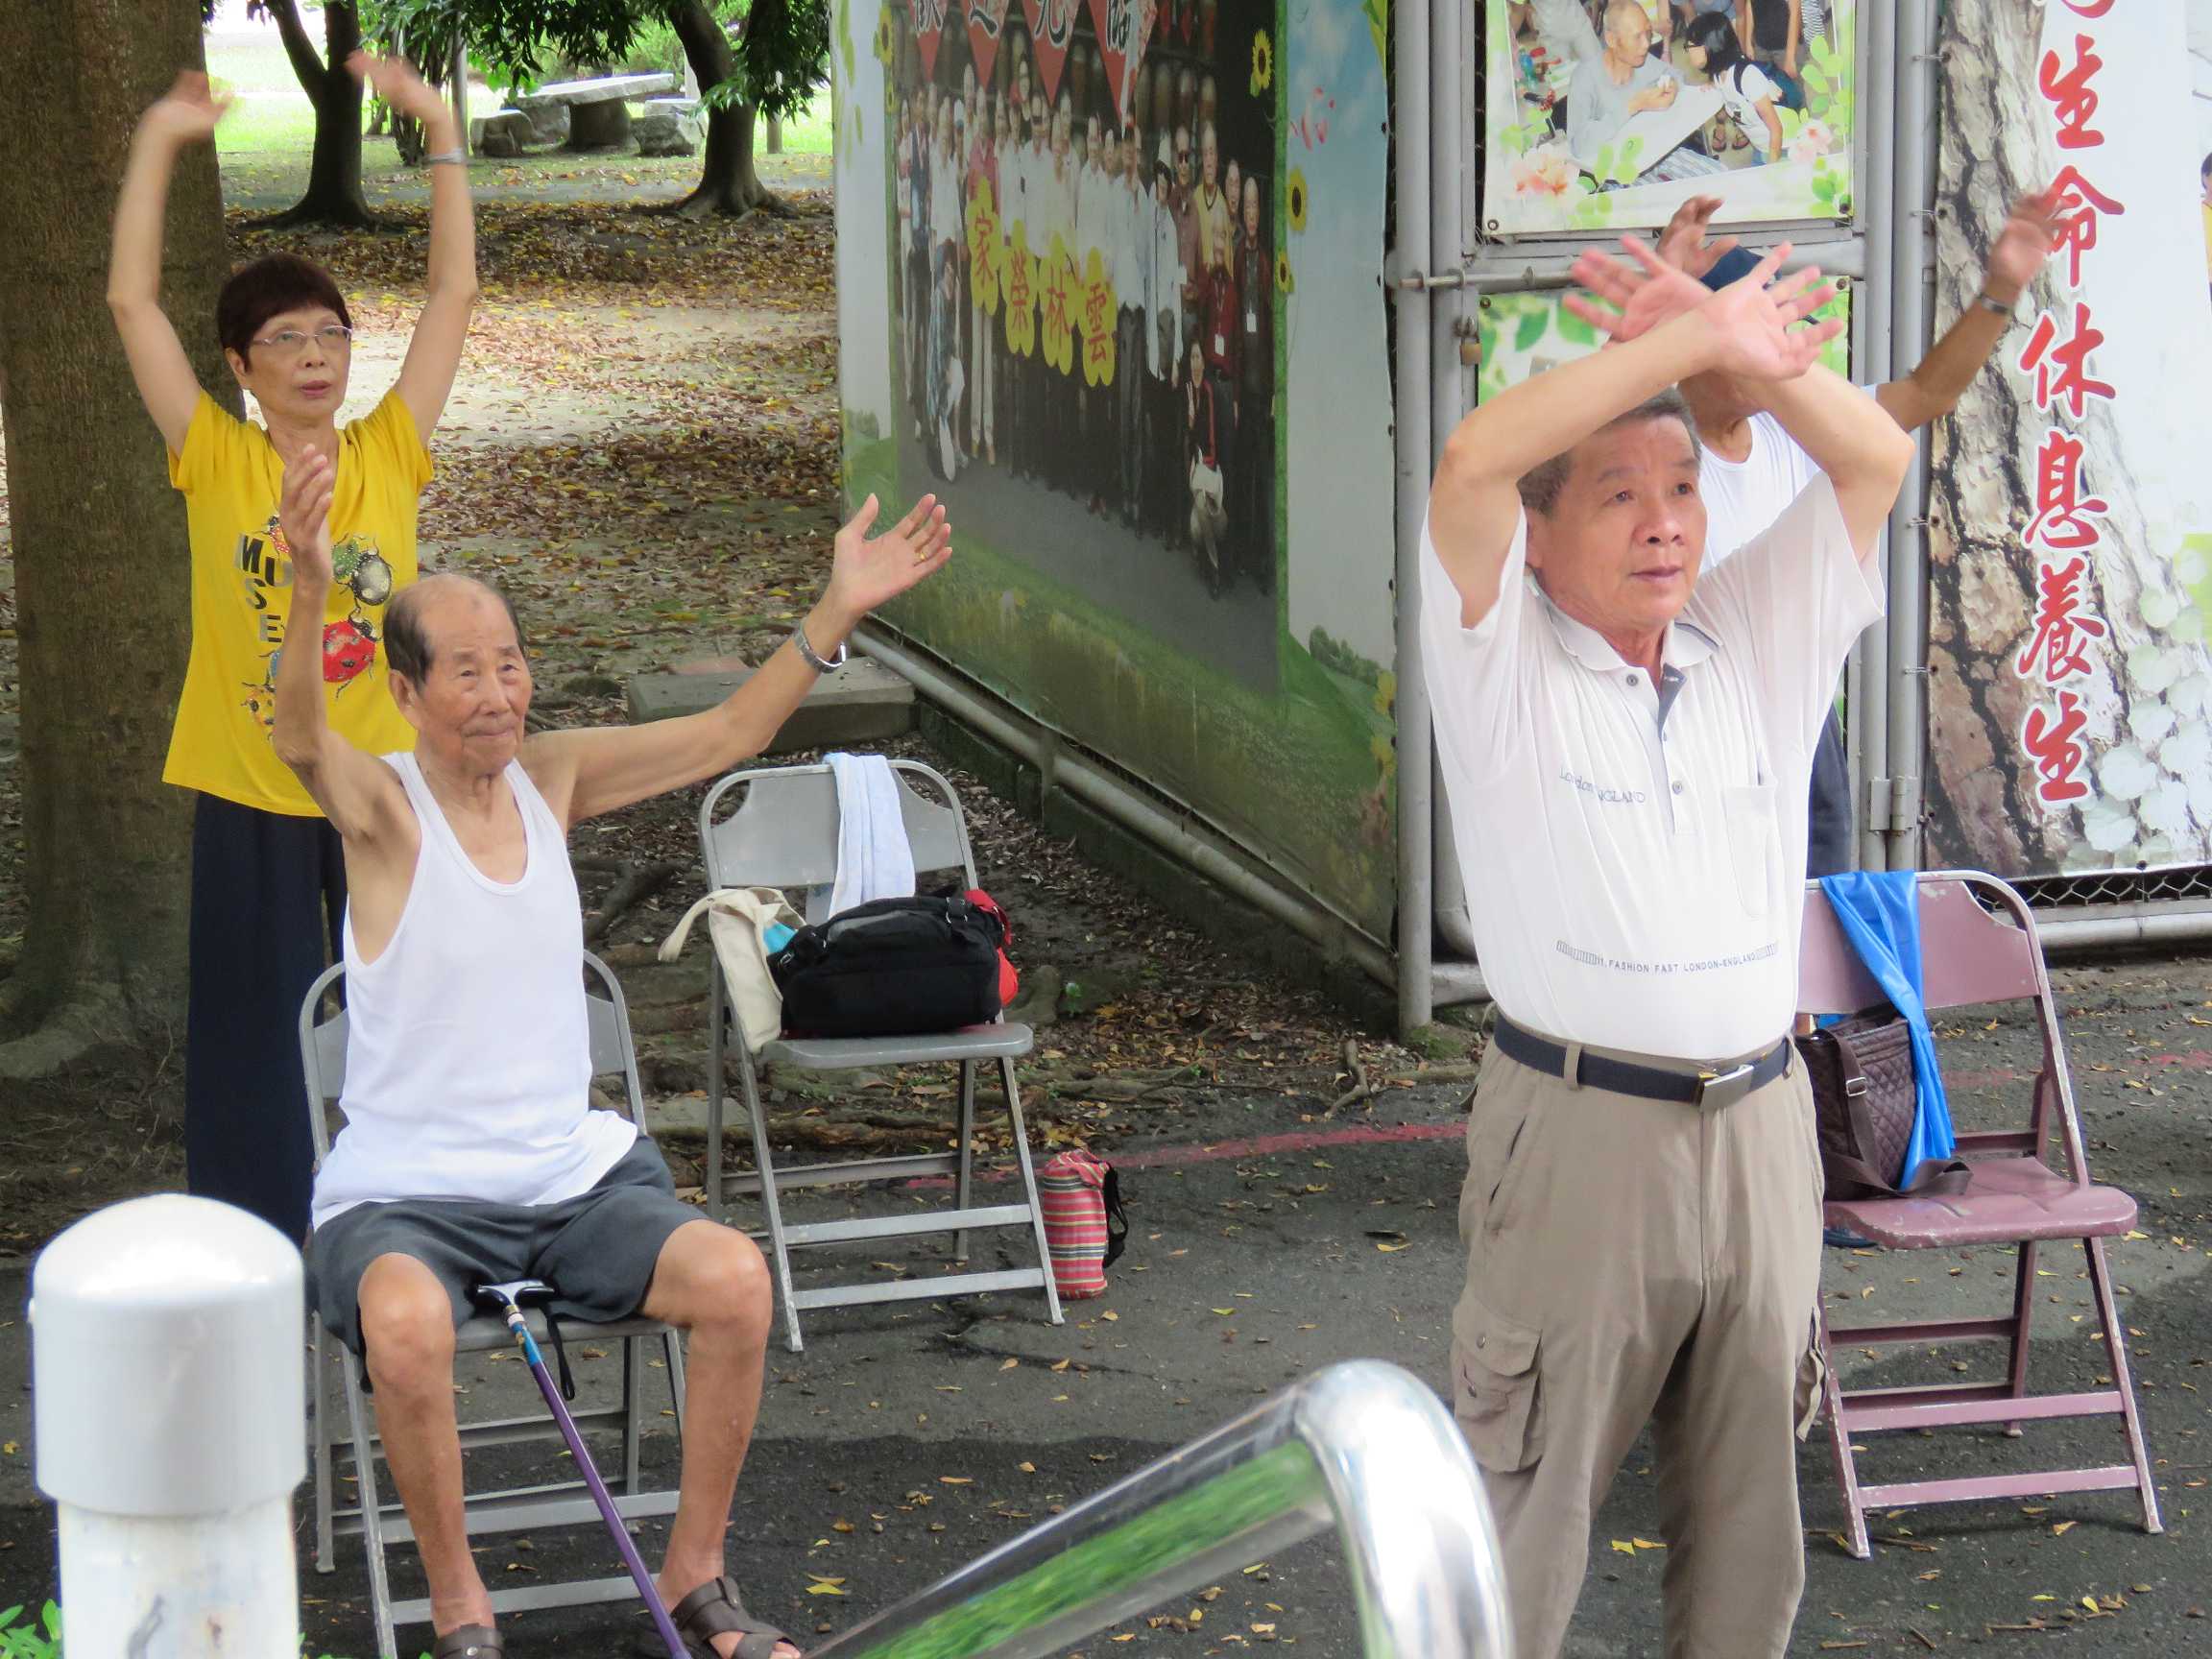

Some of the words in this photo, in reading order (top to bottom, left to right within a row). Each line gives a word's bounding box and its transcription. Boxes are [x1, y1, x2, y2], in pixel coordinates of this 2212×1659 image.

[2016, 0, 2125, 802] 生命休息養生
